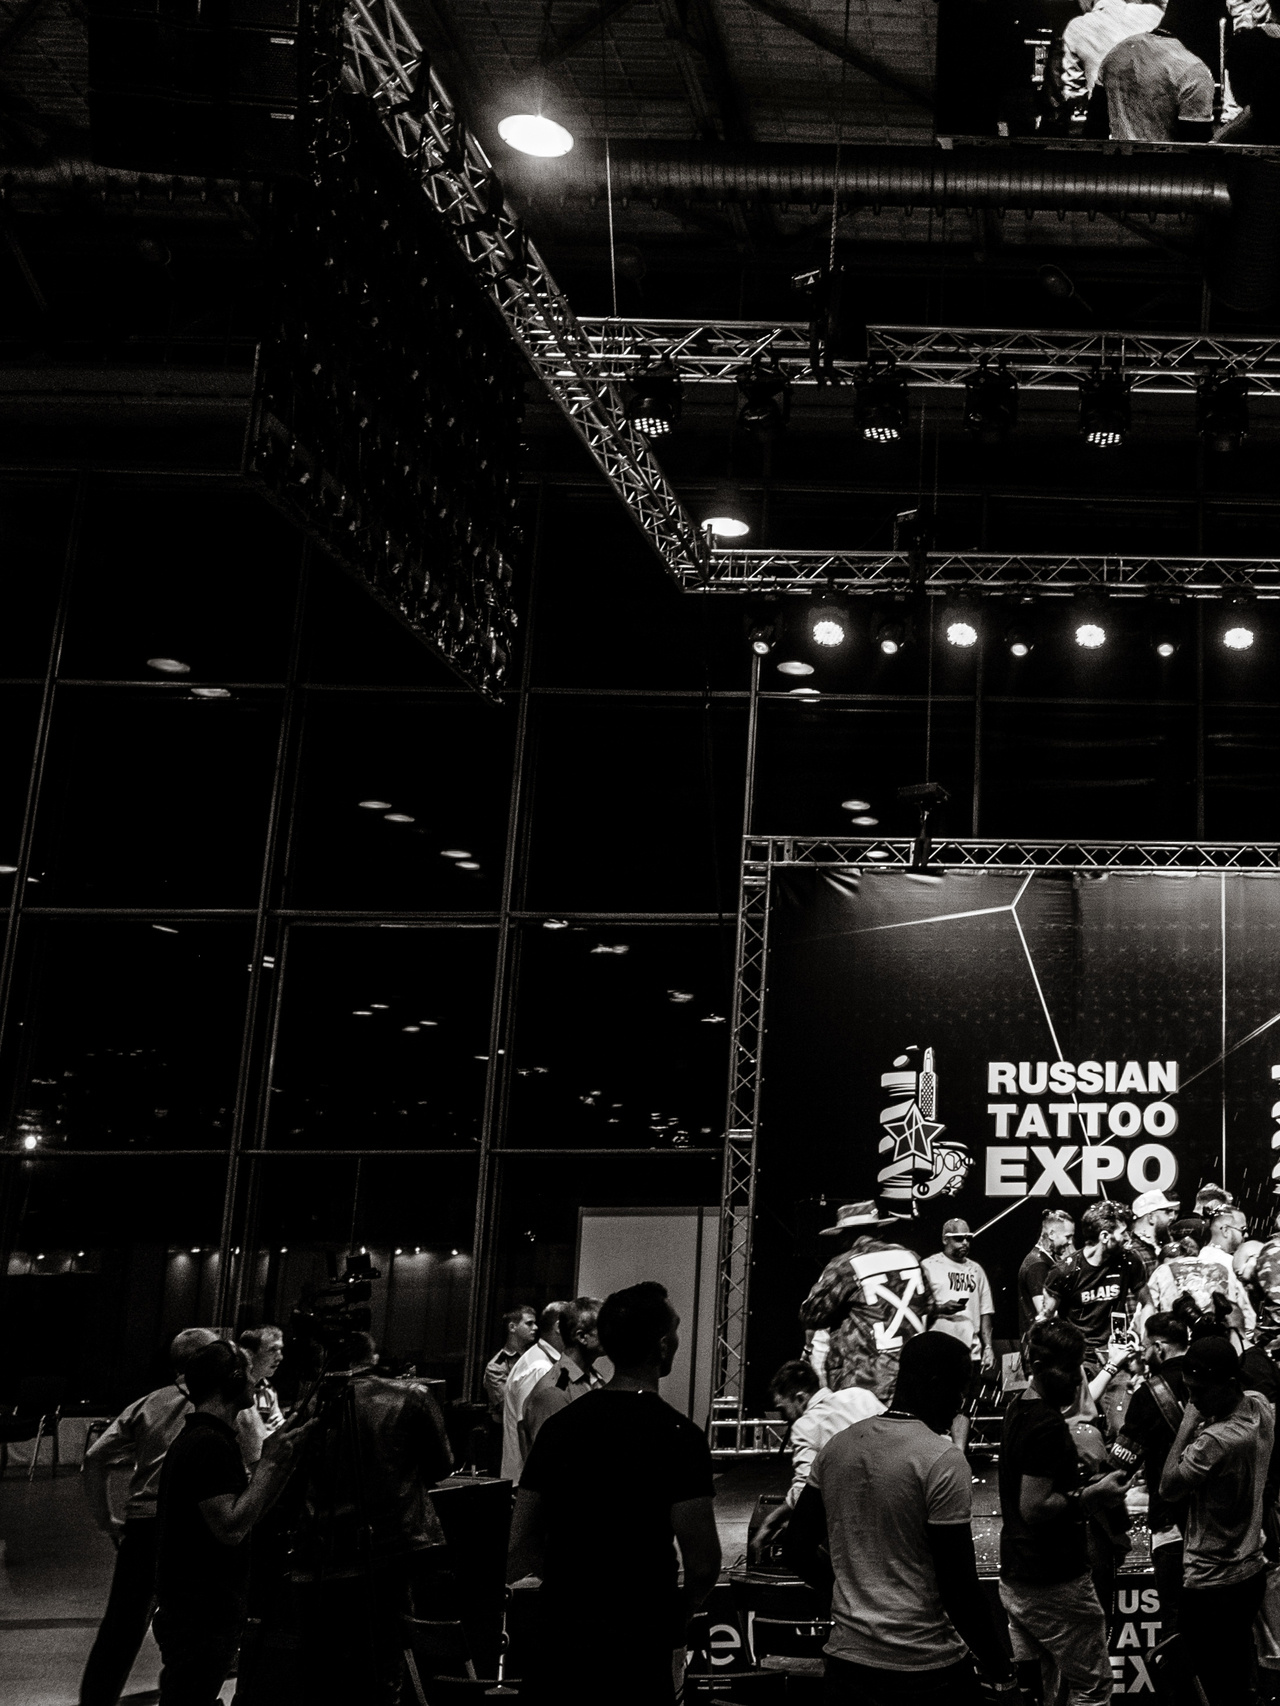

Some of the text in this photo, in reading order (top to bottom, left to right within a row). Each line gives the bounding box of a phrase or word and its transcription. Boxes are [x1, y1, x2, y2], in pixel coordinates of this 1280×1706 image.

[987, 1060, 1179, 1095] RUSSIAN
[987, 1101, 1179, 1139] TATTOO
[985, 1143, 1179, 1197] EXPO
